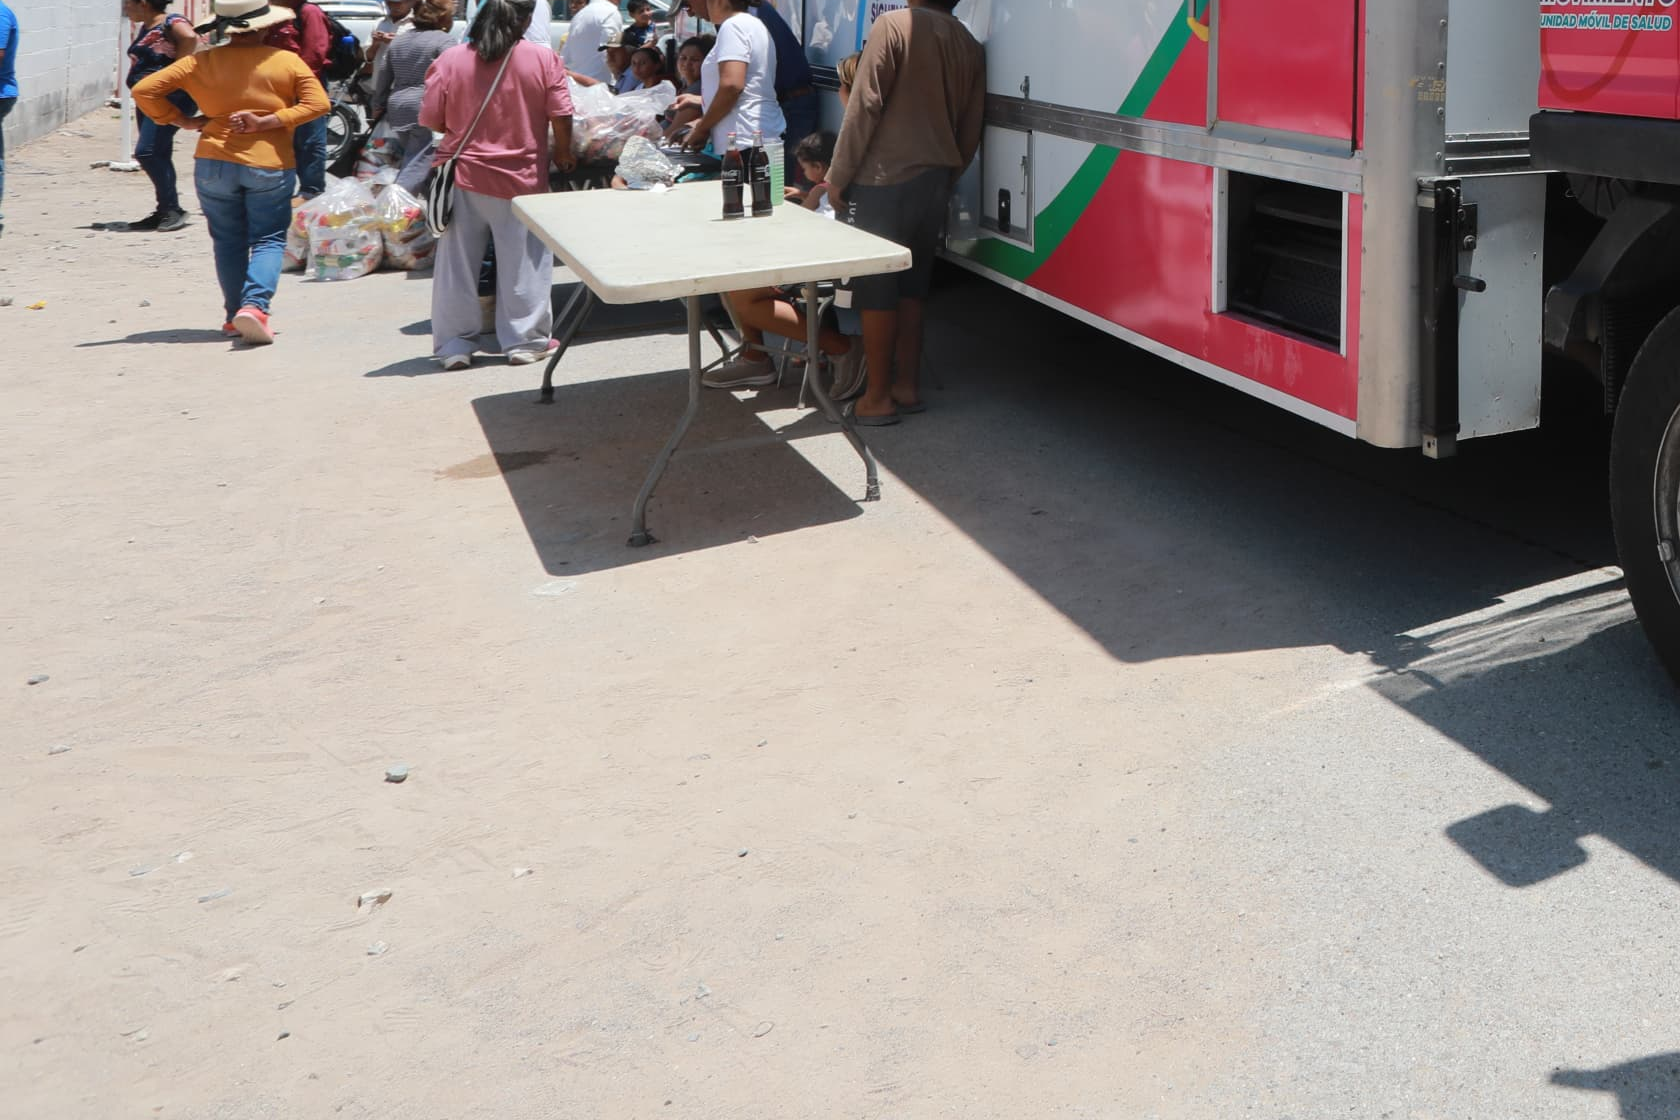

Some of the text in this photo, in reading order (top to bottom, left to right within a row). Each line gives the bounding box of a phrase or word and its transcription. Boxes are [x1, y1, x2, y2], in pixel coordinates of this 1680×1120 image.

[1540, 10, 1672, 31] UNIDAD MÓVIL DE SALUD
